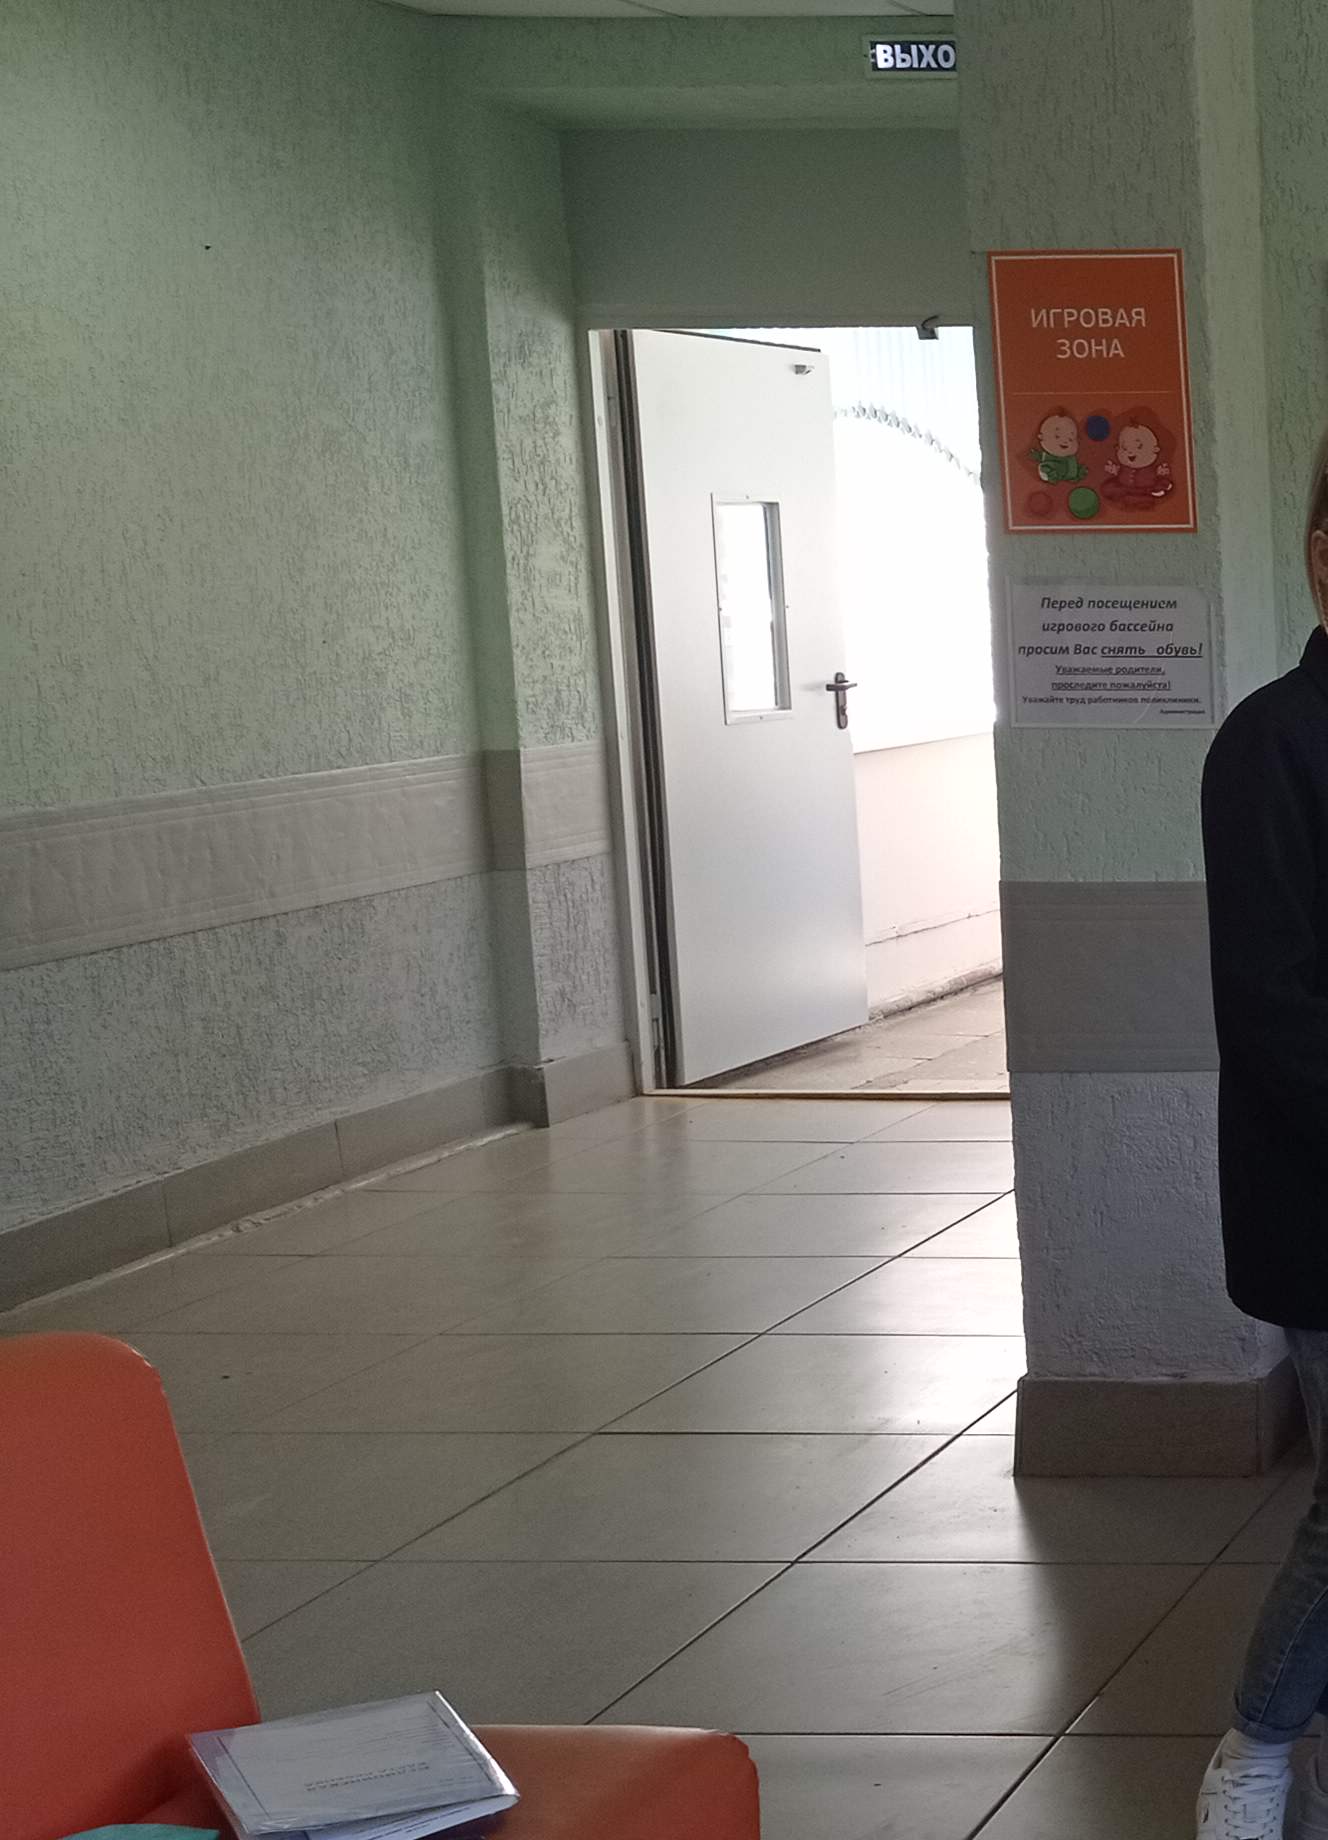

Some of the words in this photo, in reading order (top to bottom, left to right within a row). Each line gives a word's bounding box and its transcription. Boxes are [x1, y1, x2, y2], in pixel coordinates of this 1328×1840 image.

[875, 44, 956, 69] ВЫХО
[1031, 307, 1147, 329] ИГРОВАЯ
[1056, 338, 1125, 359] ЗОНА
[1041, 597, 1084, 611] Перед
[1087, 599, 1178, 612] посещением
[1042, 622, 1106, 634] игрового
[1109, 620, 1174, 632] бассейна
[1018, 645, 1070, 656] просим
[1073, 644, 1098, 656] Вас
[1101, 645, 1146, 657] снять
[1156, 643, 1204, 657] обувь!
[1055, 664, 1113, 675] Уважаемые
[1066, 696, 1086, 705] труд
